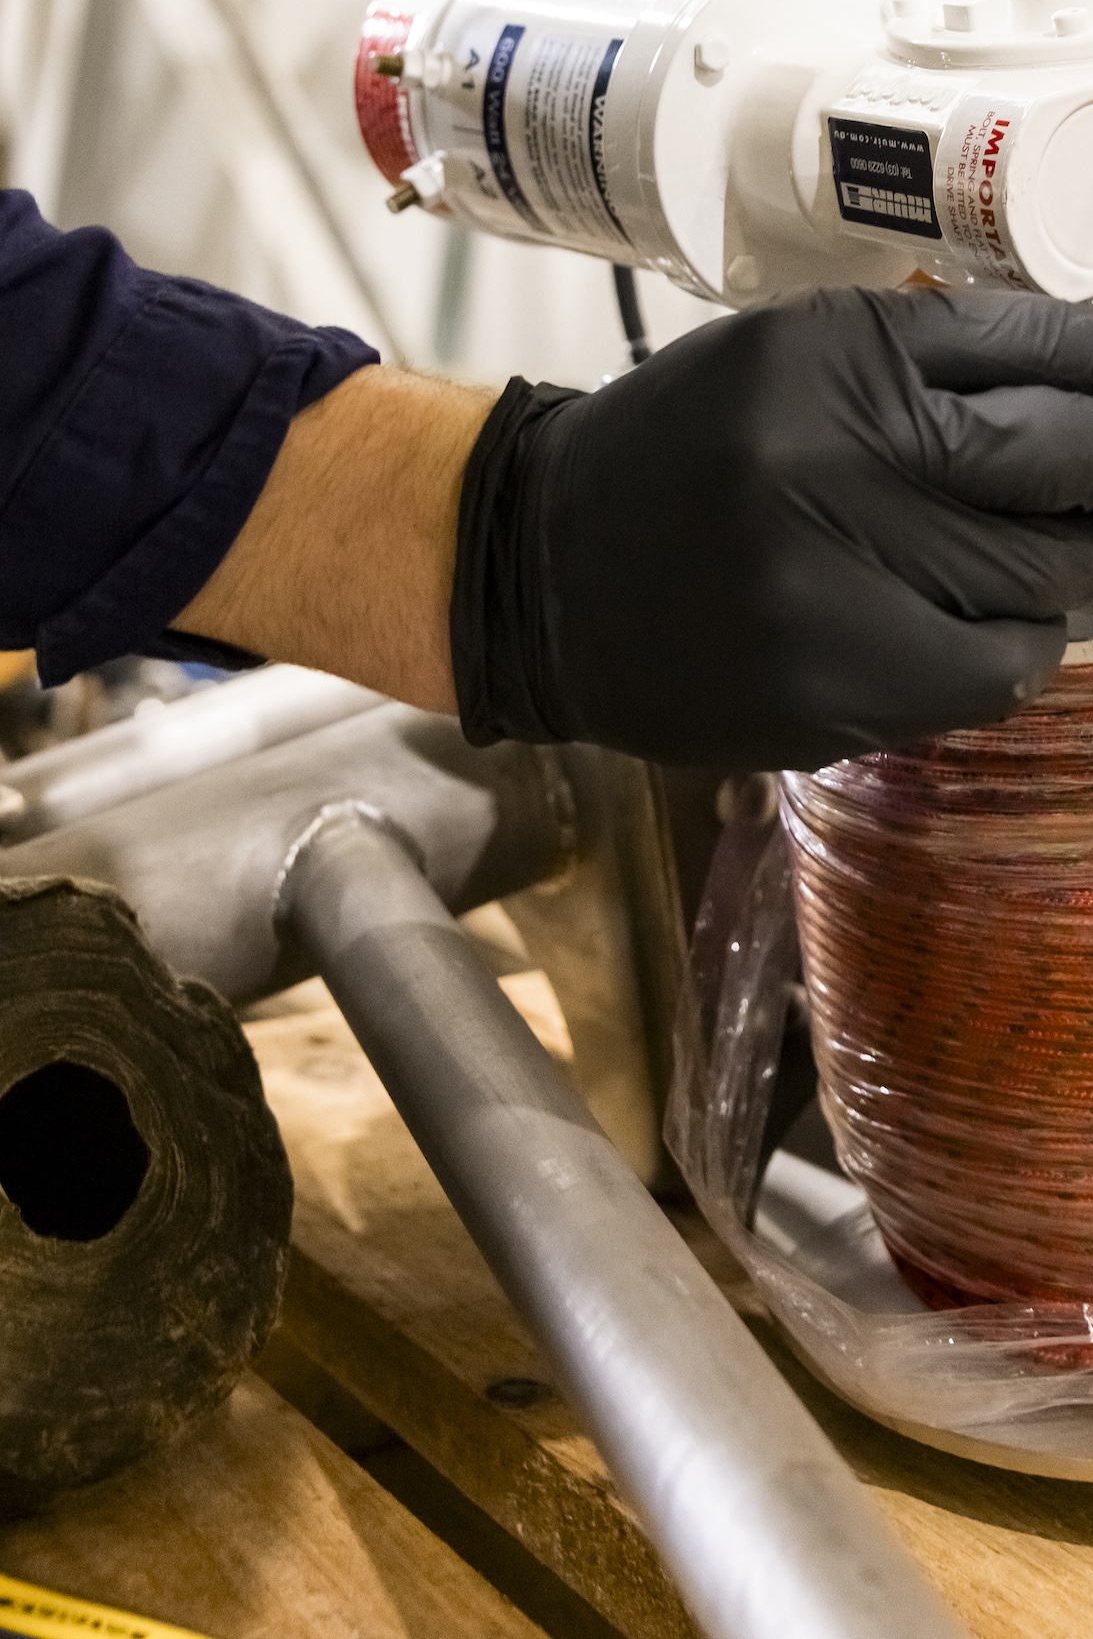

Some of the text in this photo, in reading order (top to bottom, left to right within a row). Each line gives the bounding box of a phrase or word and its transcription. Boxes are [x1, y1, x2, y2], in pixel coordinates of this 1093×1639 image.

[489, 36, 516, 83] 600
[834, 129, 925, 153] www.muir.com.au
[961, 124, 977, 160] MUST
[885, 160, 900, 177] (03)
[946, 166, 955, 202] DRIVE
[957, 162, 967, 179] BE
[967, 144, 982, 192] SPRING
[871, 186, 933, 224] MUIR
[957, 182, 967, 220] FITTED
[967, 195, 978, 226] AND
[962, 224, 973, 240] TO
